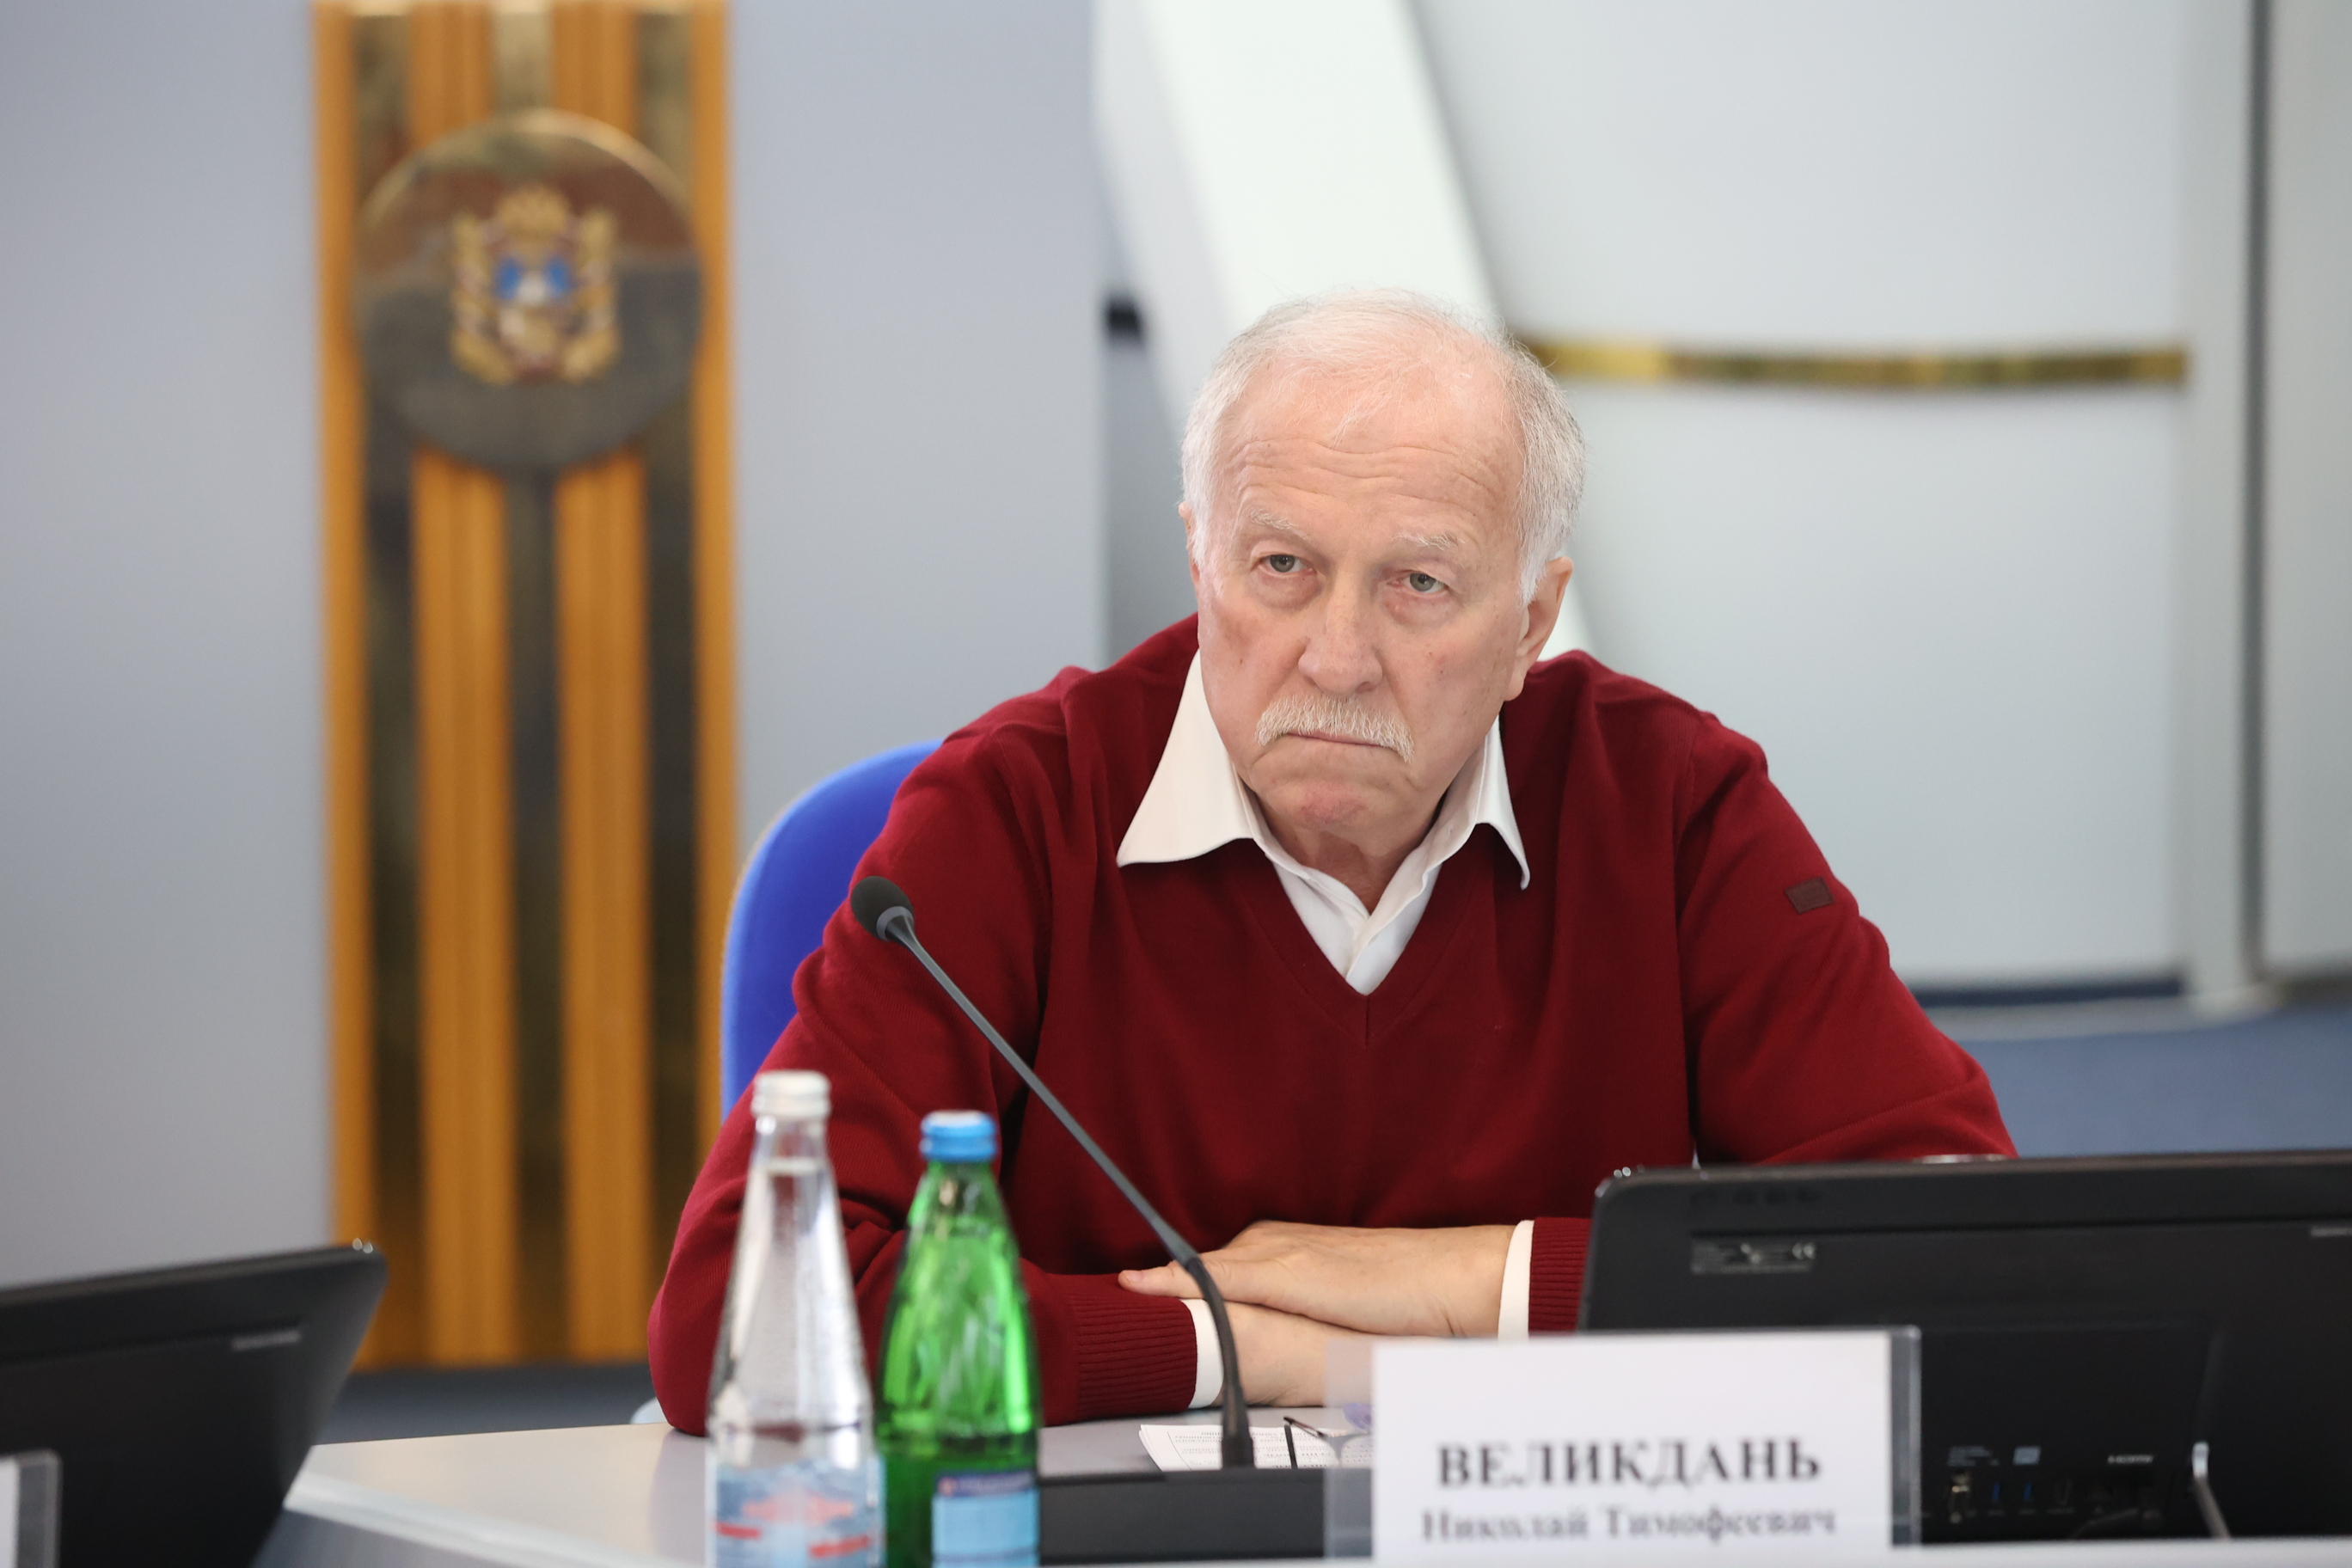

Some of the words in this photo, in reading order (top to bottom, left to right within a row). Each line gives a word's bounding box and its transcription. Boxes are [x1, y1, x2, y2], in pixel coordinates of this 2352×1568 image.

[1436, 1436, 1822, 1489] ВЕЛИКДАНЬ
[1422, 1508, 1589, 1541] Николай
[1604, 1505, 1836, 1544] Тимофеевич
